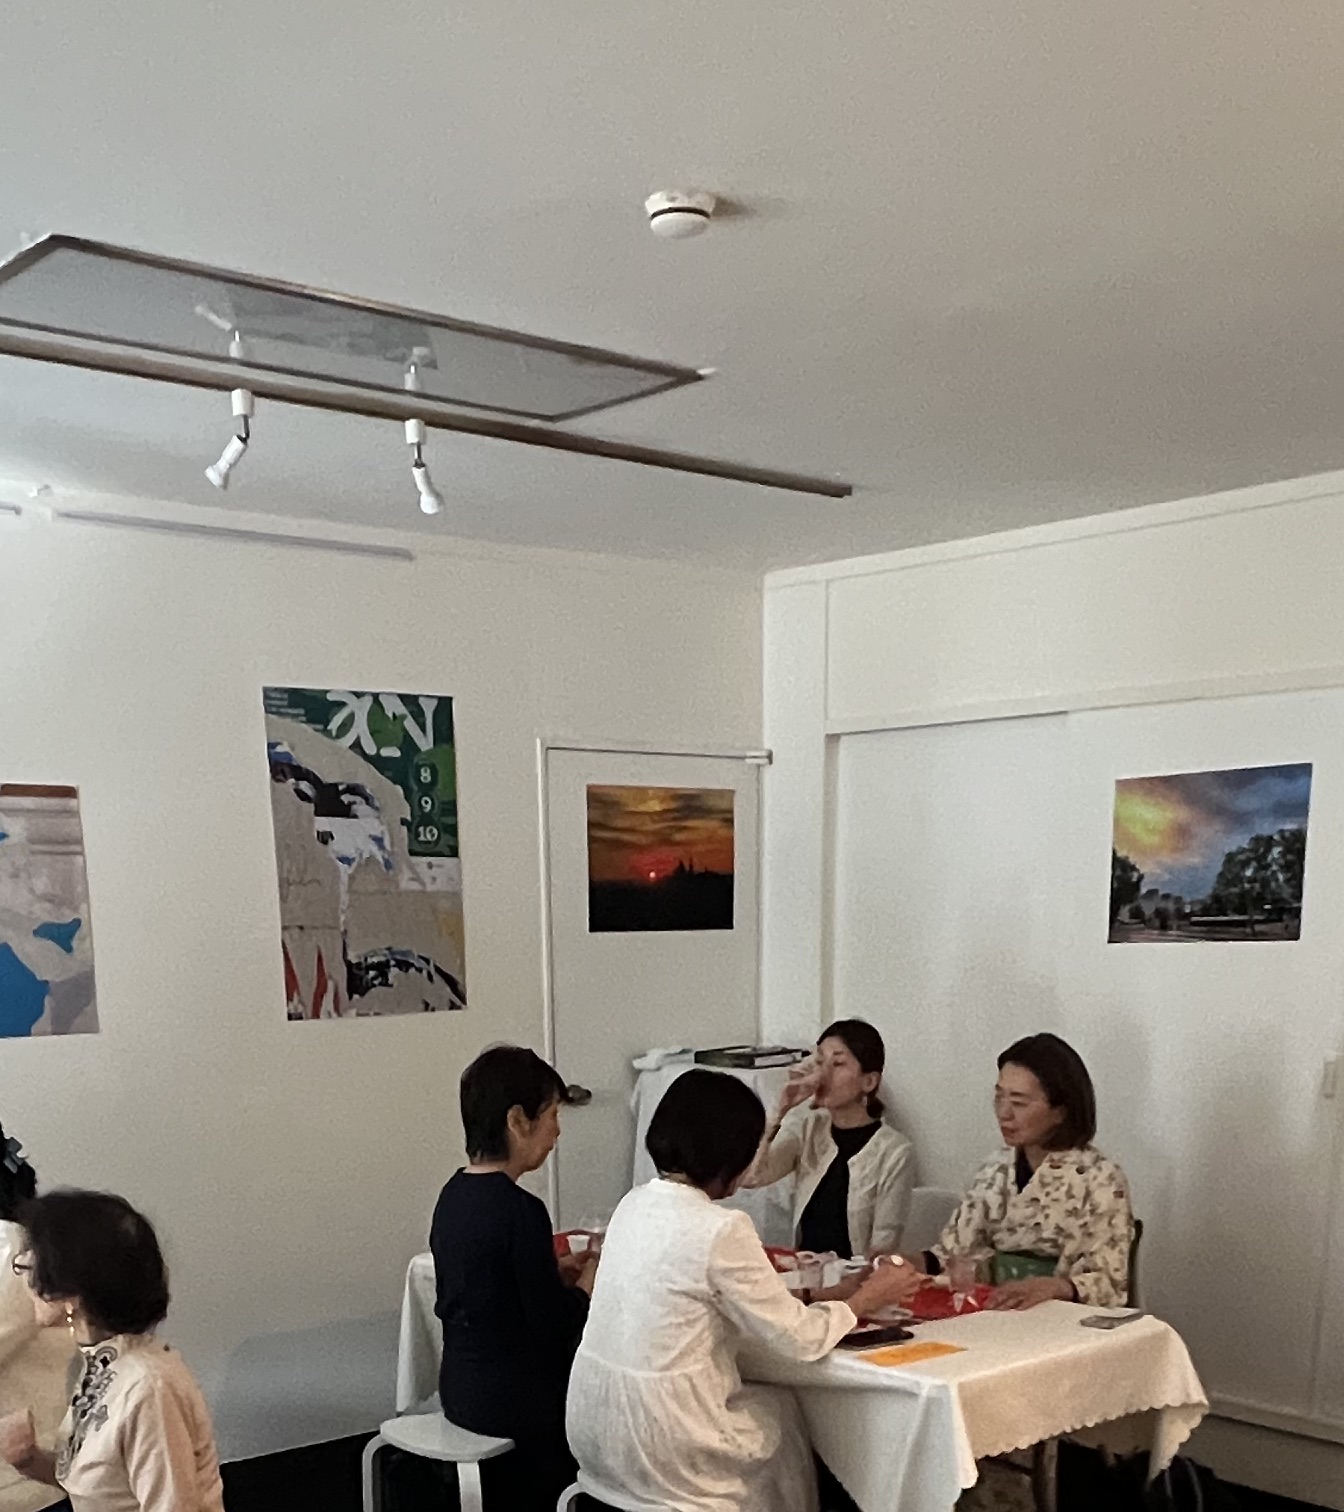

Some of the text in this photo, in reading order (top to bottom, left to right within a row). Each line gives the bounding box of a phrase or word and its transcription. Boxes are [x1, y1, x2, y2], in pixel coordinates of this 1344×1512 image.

[420, 767, 432, 783] 8
[420, 798, 432, 812] 9
[417, 827, 439, 842] 10
